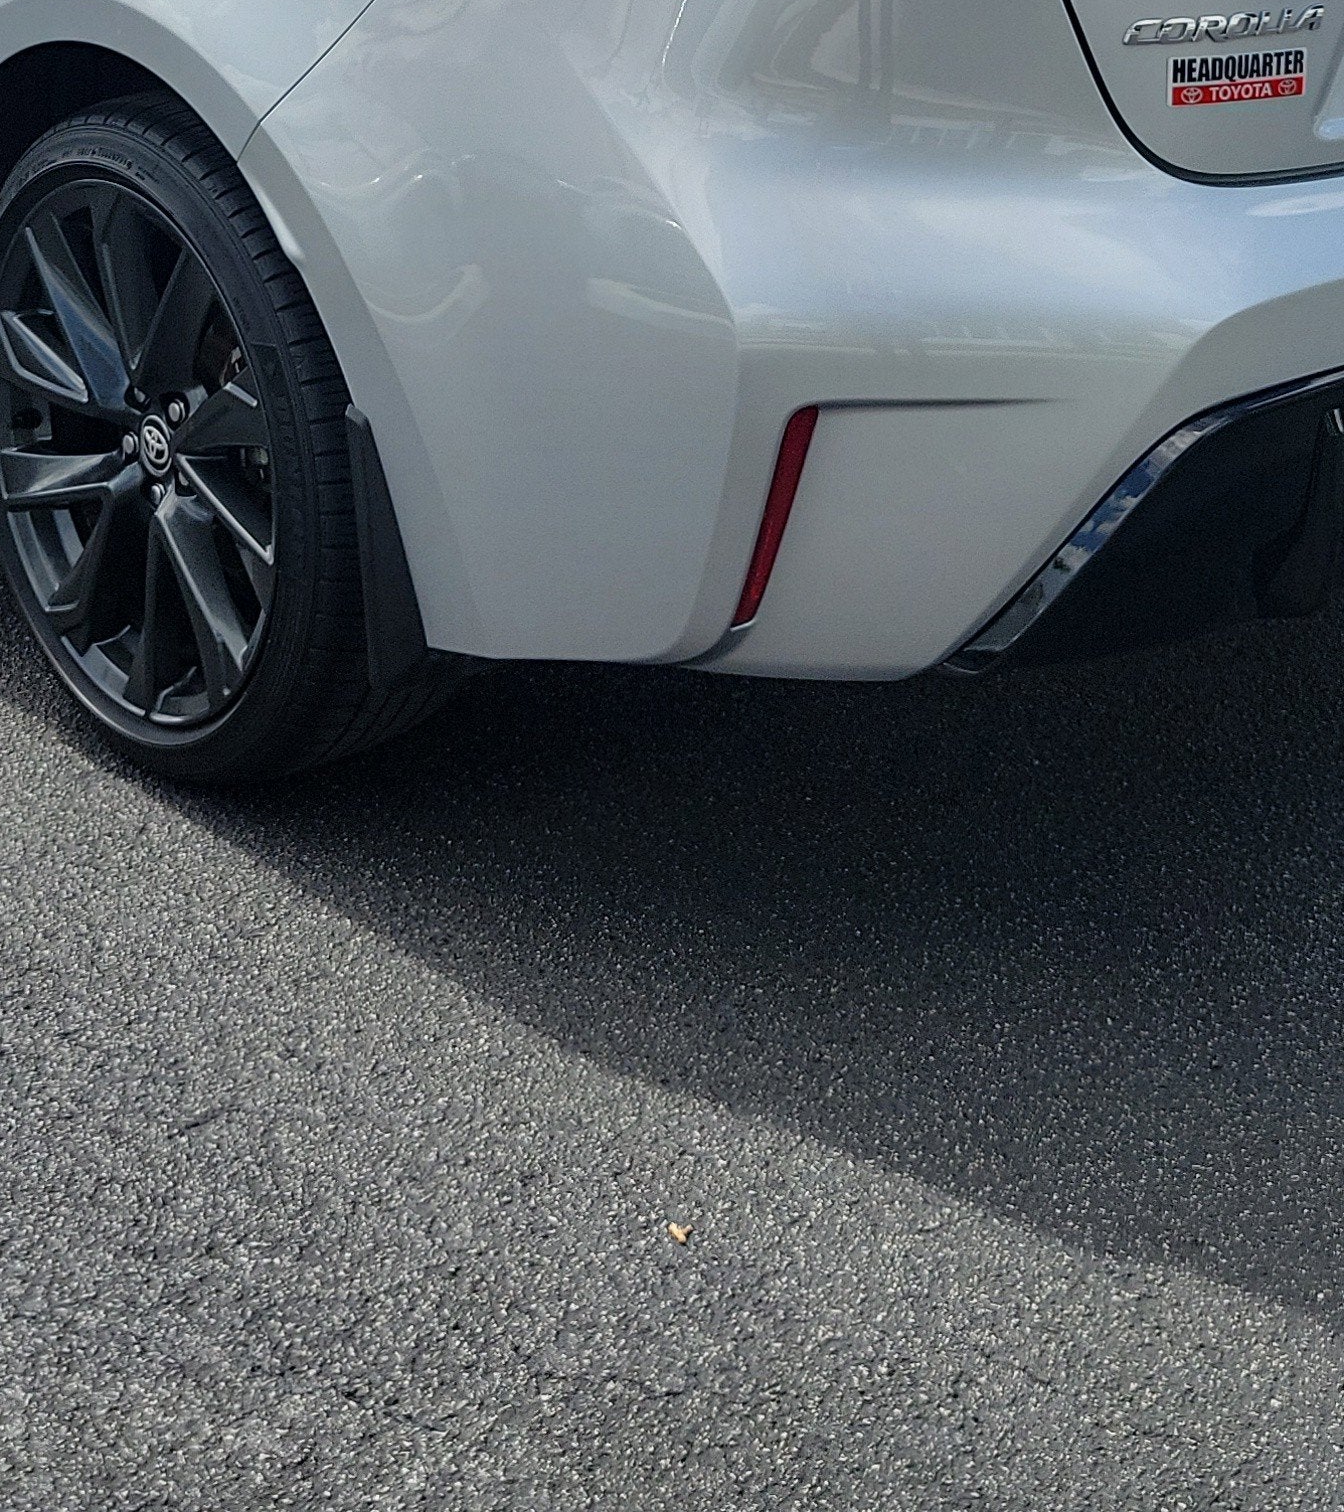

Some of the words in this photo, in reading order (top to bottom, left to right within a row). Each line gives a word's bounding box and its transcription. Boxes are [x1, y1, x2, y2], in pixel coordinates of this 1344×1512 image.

[1122, 2, 1325, 45] COROLLA
[1172, 49, 1305, 84] HEADQUARTER
[1208, 82, 1273, 102] TOYOTA
